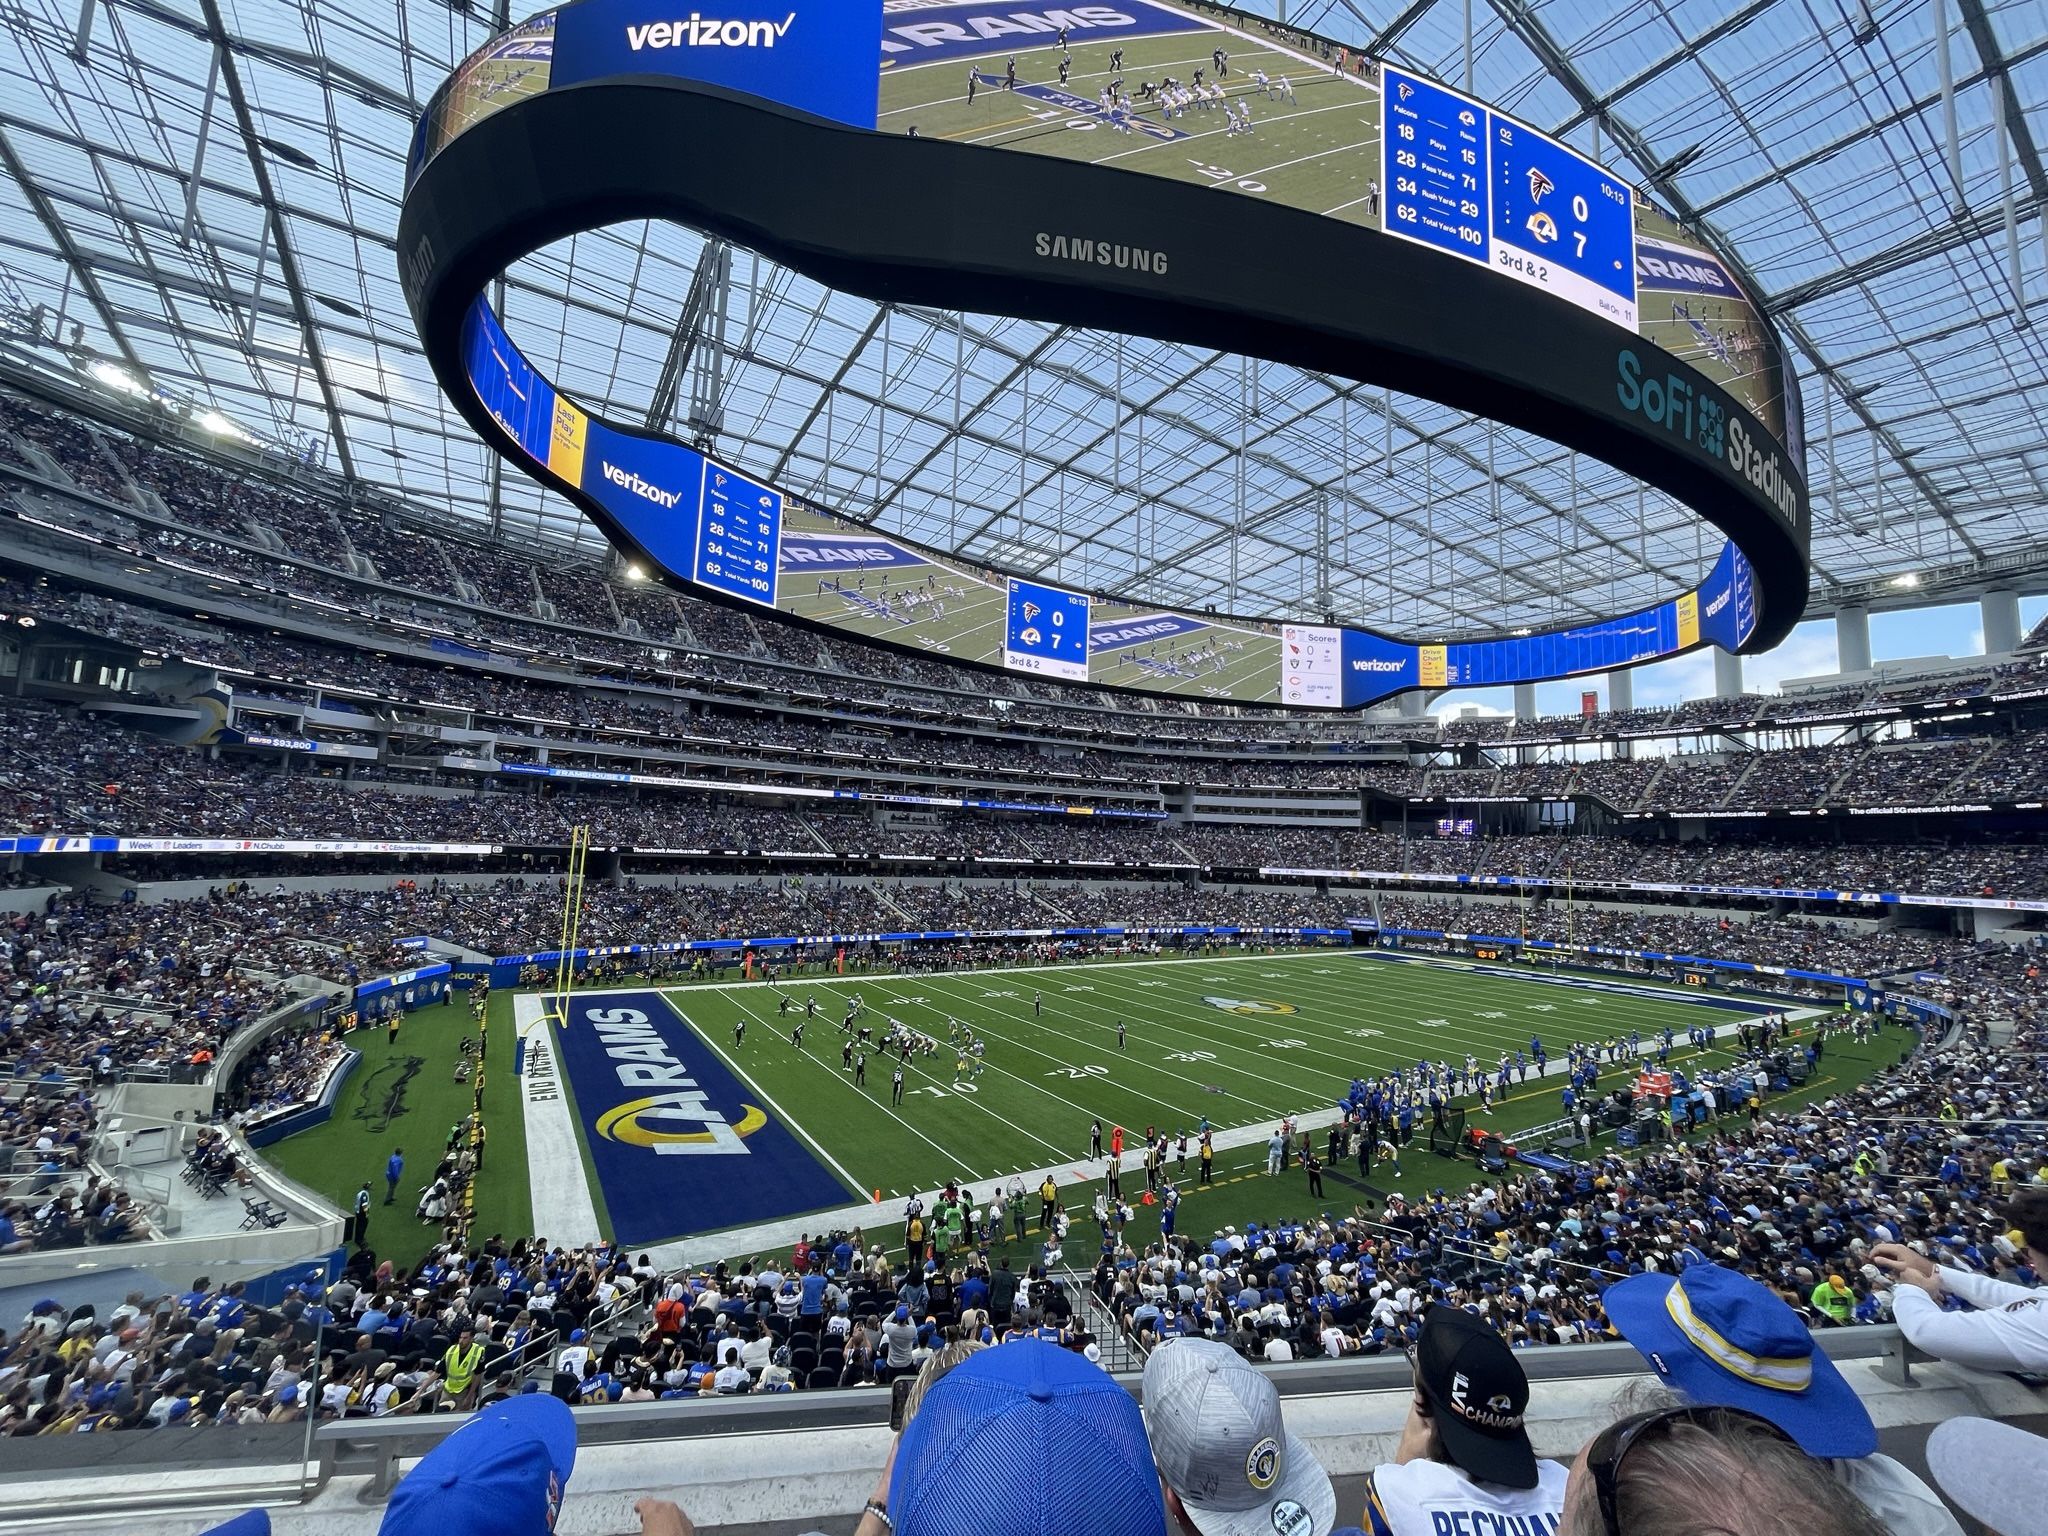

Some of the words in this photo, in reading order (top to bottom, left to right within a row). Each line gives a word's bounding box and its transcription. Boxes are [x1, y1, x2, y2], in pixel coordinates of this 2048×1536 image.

[626, 13, 775, 51] verizon
[909, 6, 1138, 47] RAMS
[1393, 104, 1418, 120] Falcons
[1397, 123, 1415, 141] 18
[1429, 138, 1447, 152] Plays
[1461, 148, 1476, 166] 15
[1499, 128, 1513, 141] Q2
[1396, 149, 1417, 169] 28
[1421, 162, 1438, 175] Pass
[1437, 167, 1456, 182] Yards
[1461, 174, 1477, 191] 71
[1396, 177, 1418, 196] 34
[1421, 189, 1438, 202] Rush
[1438, 193, 1457, 208] Yards
[1460, 200, 1479, 218] 29
[1600, 182, 1625, 206] 10:13
[1572, 195, 1589, 223] 0
[1397, 204, 1418, 224] 62
[1421, 216, 1438, 229] Total
[1438, 221, 1457, 236] Yards
[1458, 225, 1482, 246] 100
[1035, 232, 1168, 275] SAMSUNG
[1572, 231, 1588, 259] 7
[1499, 250, 1523, 273] 3rd
[1526, 260, 1537, 278] &
[1539, 266, 1549, 283] 2
[1640, 256, 1725, 288] RAMS
[1624, 308, 1632, 322] 11
[557, 402, 576, 424] Last
[556, 415, 574, 437] Play
[1617, 349, 1693, 441] SoFi
[1728, 416, 1796, 527] Stadium
[601, 460, 672, 509] verizon
[713, 503, 725, 516] 18
[758, 523, 770, 535] 15
[709, 522, 724, 536] 28
[757, 541, 768, 554] 71
[707, 542, 723, 556] 34
[754, 560, 769, 573] 29
[791, 547, 895, 563] RAMS
[706, 562, 721, 576] 62
[751, 578, 769, 592] 100
[1068, 596, 1087, 607] 10:13
[1706, 587, 1730, 617] verizon
[1052, 611, 1064, 627] 0
[1051, 633, 1062, 649] 7
[1093, 621, 1181, 645] RAMS
[1308, 633, 1337, 643] Scores
[1306, 645, 1314, 656] 0
[1009, 655, 1025, 667] 3rd
[1026, 658, 1033, 668] &
[1034, 660, 1040, 669] 2
[1306, 660, 1313, 670] 7
[1353, 659, 1400, 672] verizon
[273, 739, 311, 750] $93,800
[1866, 806, 1892, 814] official
[1893, 806, 1907, 814] 5G
[129, 841, 153, 849] Week
[173, 841, 203, 849] Leaders
[588, 946, 632, 956] RAMS
[1478, 950, 1496, 959] 10:13
[1554, 943, 1590, 951] RAMS
[1597, 947, 1642, 957] HOUSE
[585, 1008, 698, 1087] RAMS
[1269, 1039, 1308, 1049] 40
[1171, 1050, 1217, 1062] 30
[1056, 1065, 1109, 1079] 20
[528, 1081, 558, 1102] END
[921, 1082, 978, 1098] 10
